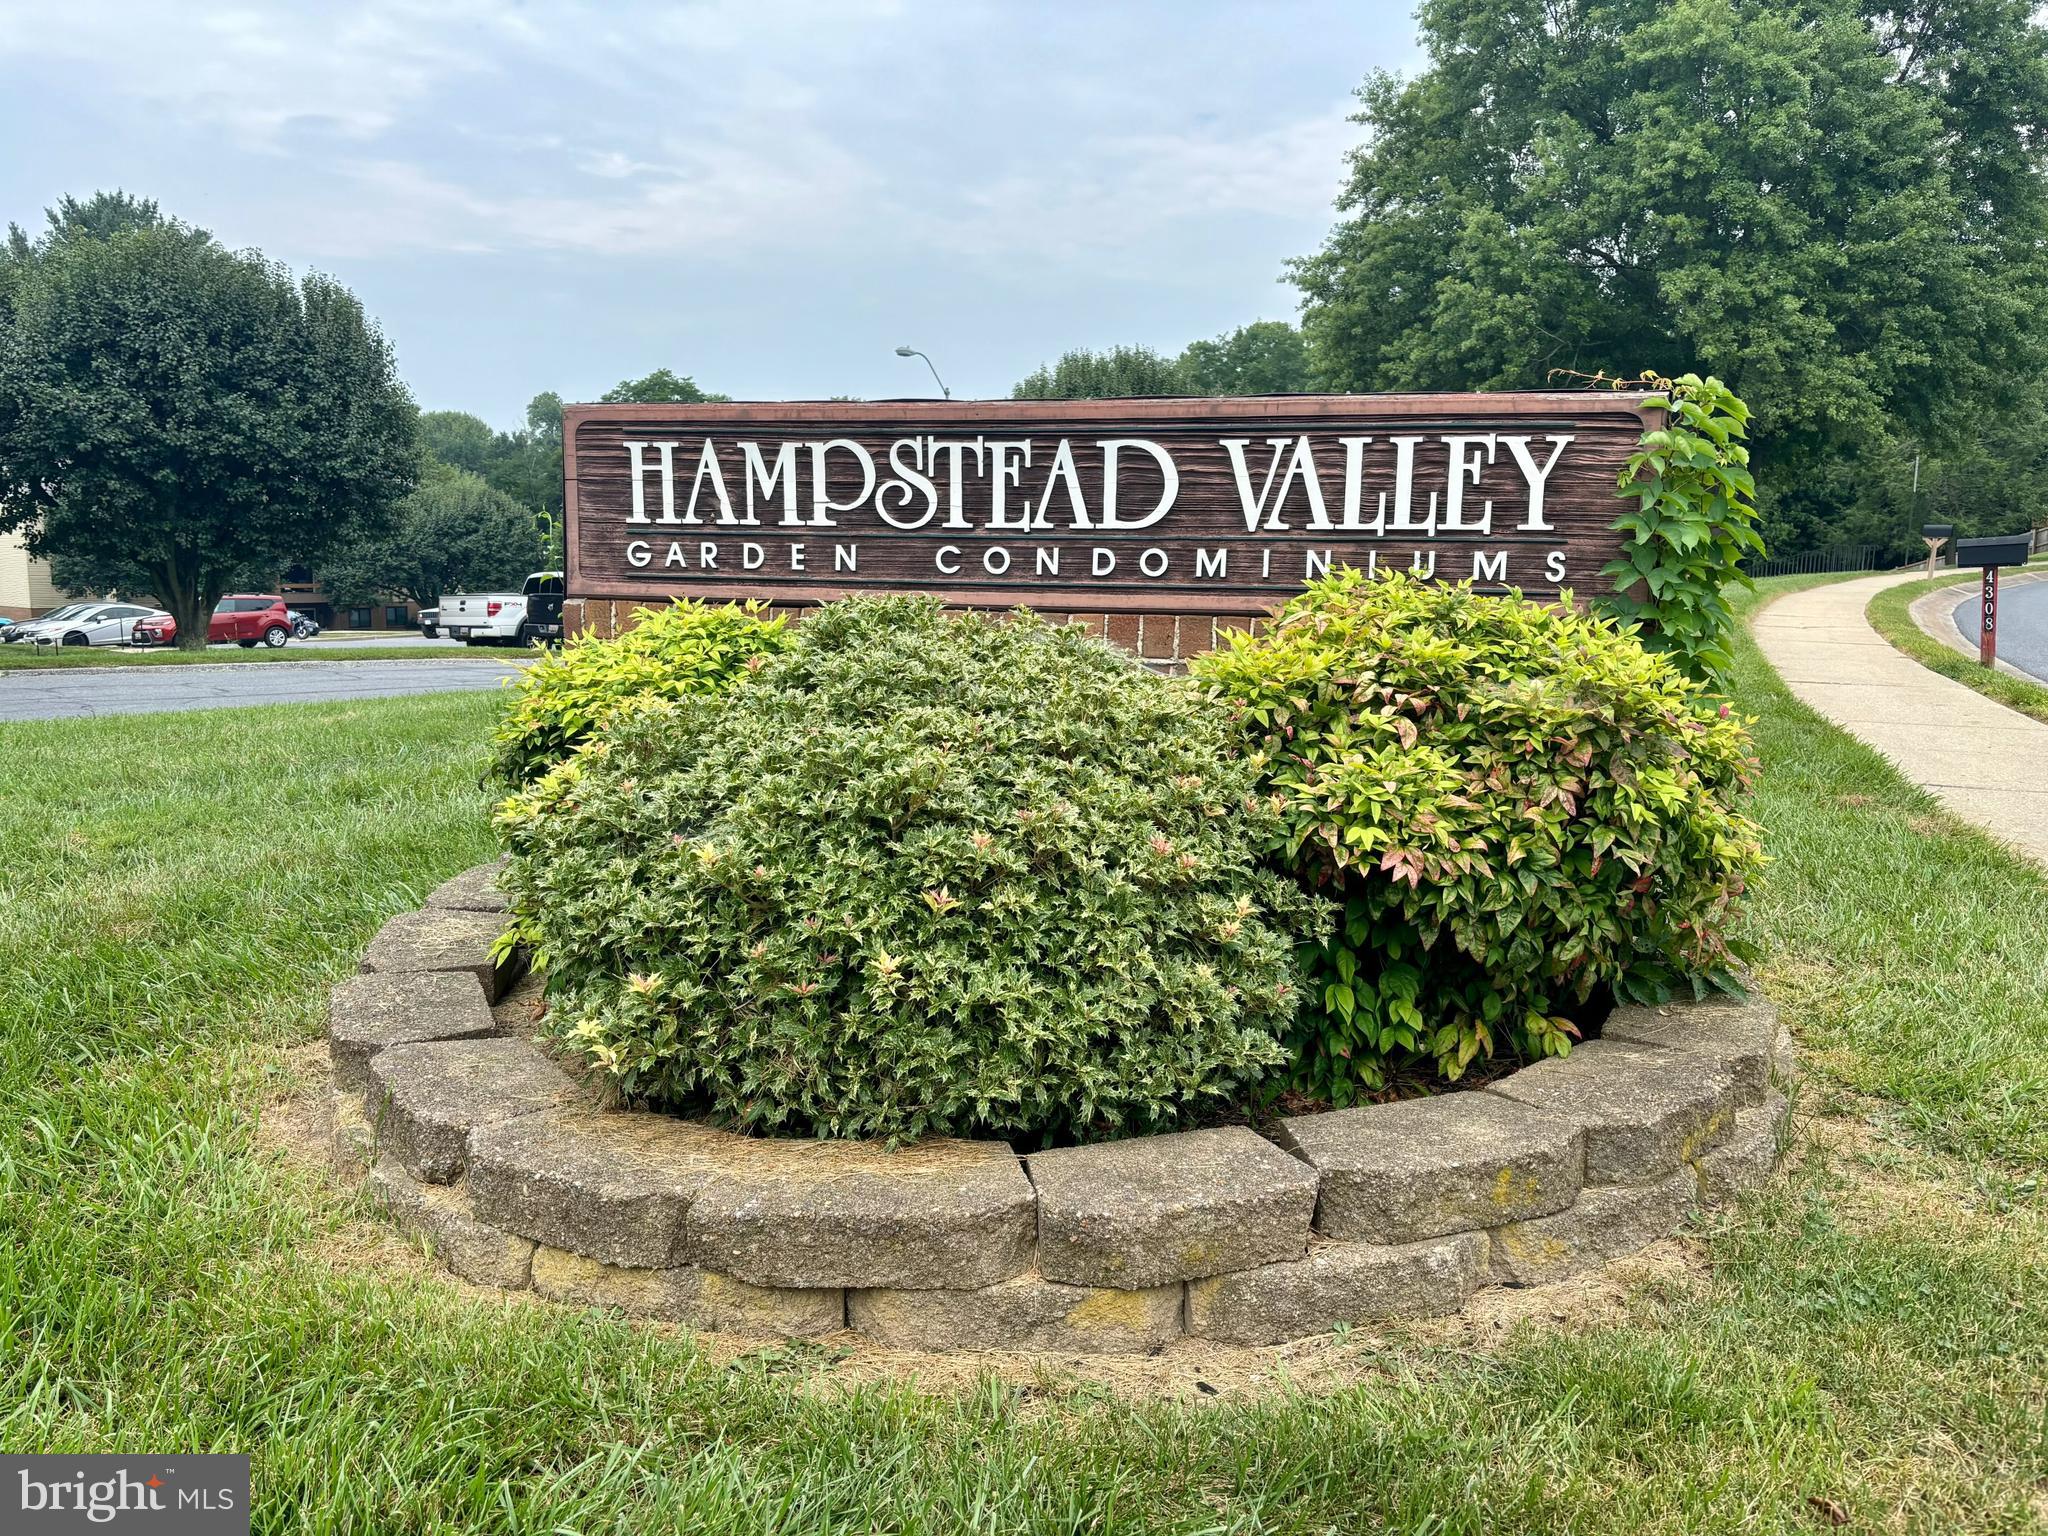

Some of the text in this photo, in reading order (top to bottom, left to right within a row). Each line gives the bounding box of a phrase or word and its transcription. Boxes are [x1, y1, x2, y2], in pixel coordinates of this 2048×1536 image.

[622, 433, 1574, 536] HAMPSTEAD VALLEY
[626, 540, 1567, 582] GARDEN CONDOMINIUMS
[1985, 570, 1994, 630] 4308
